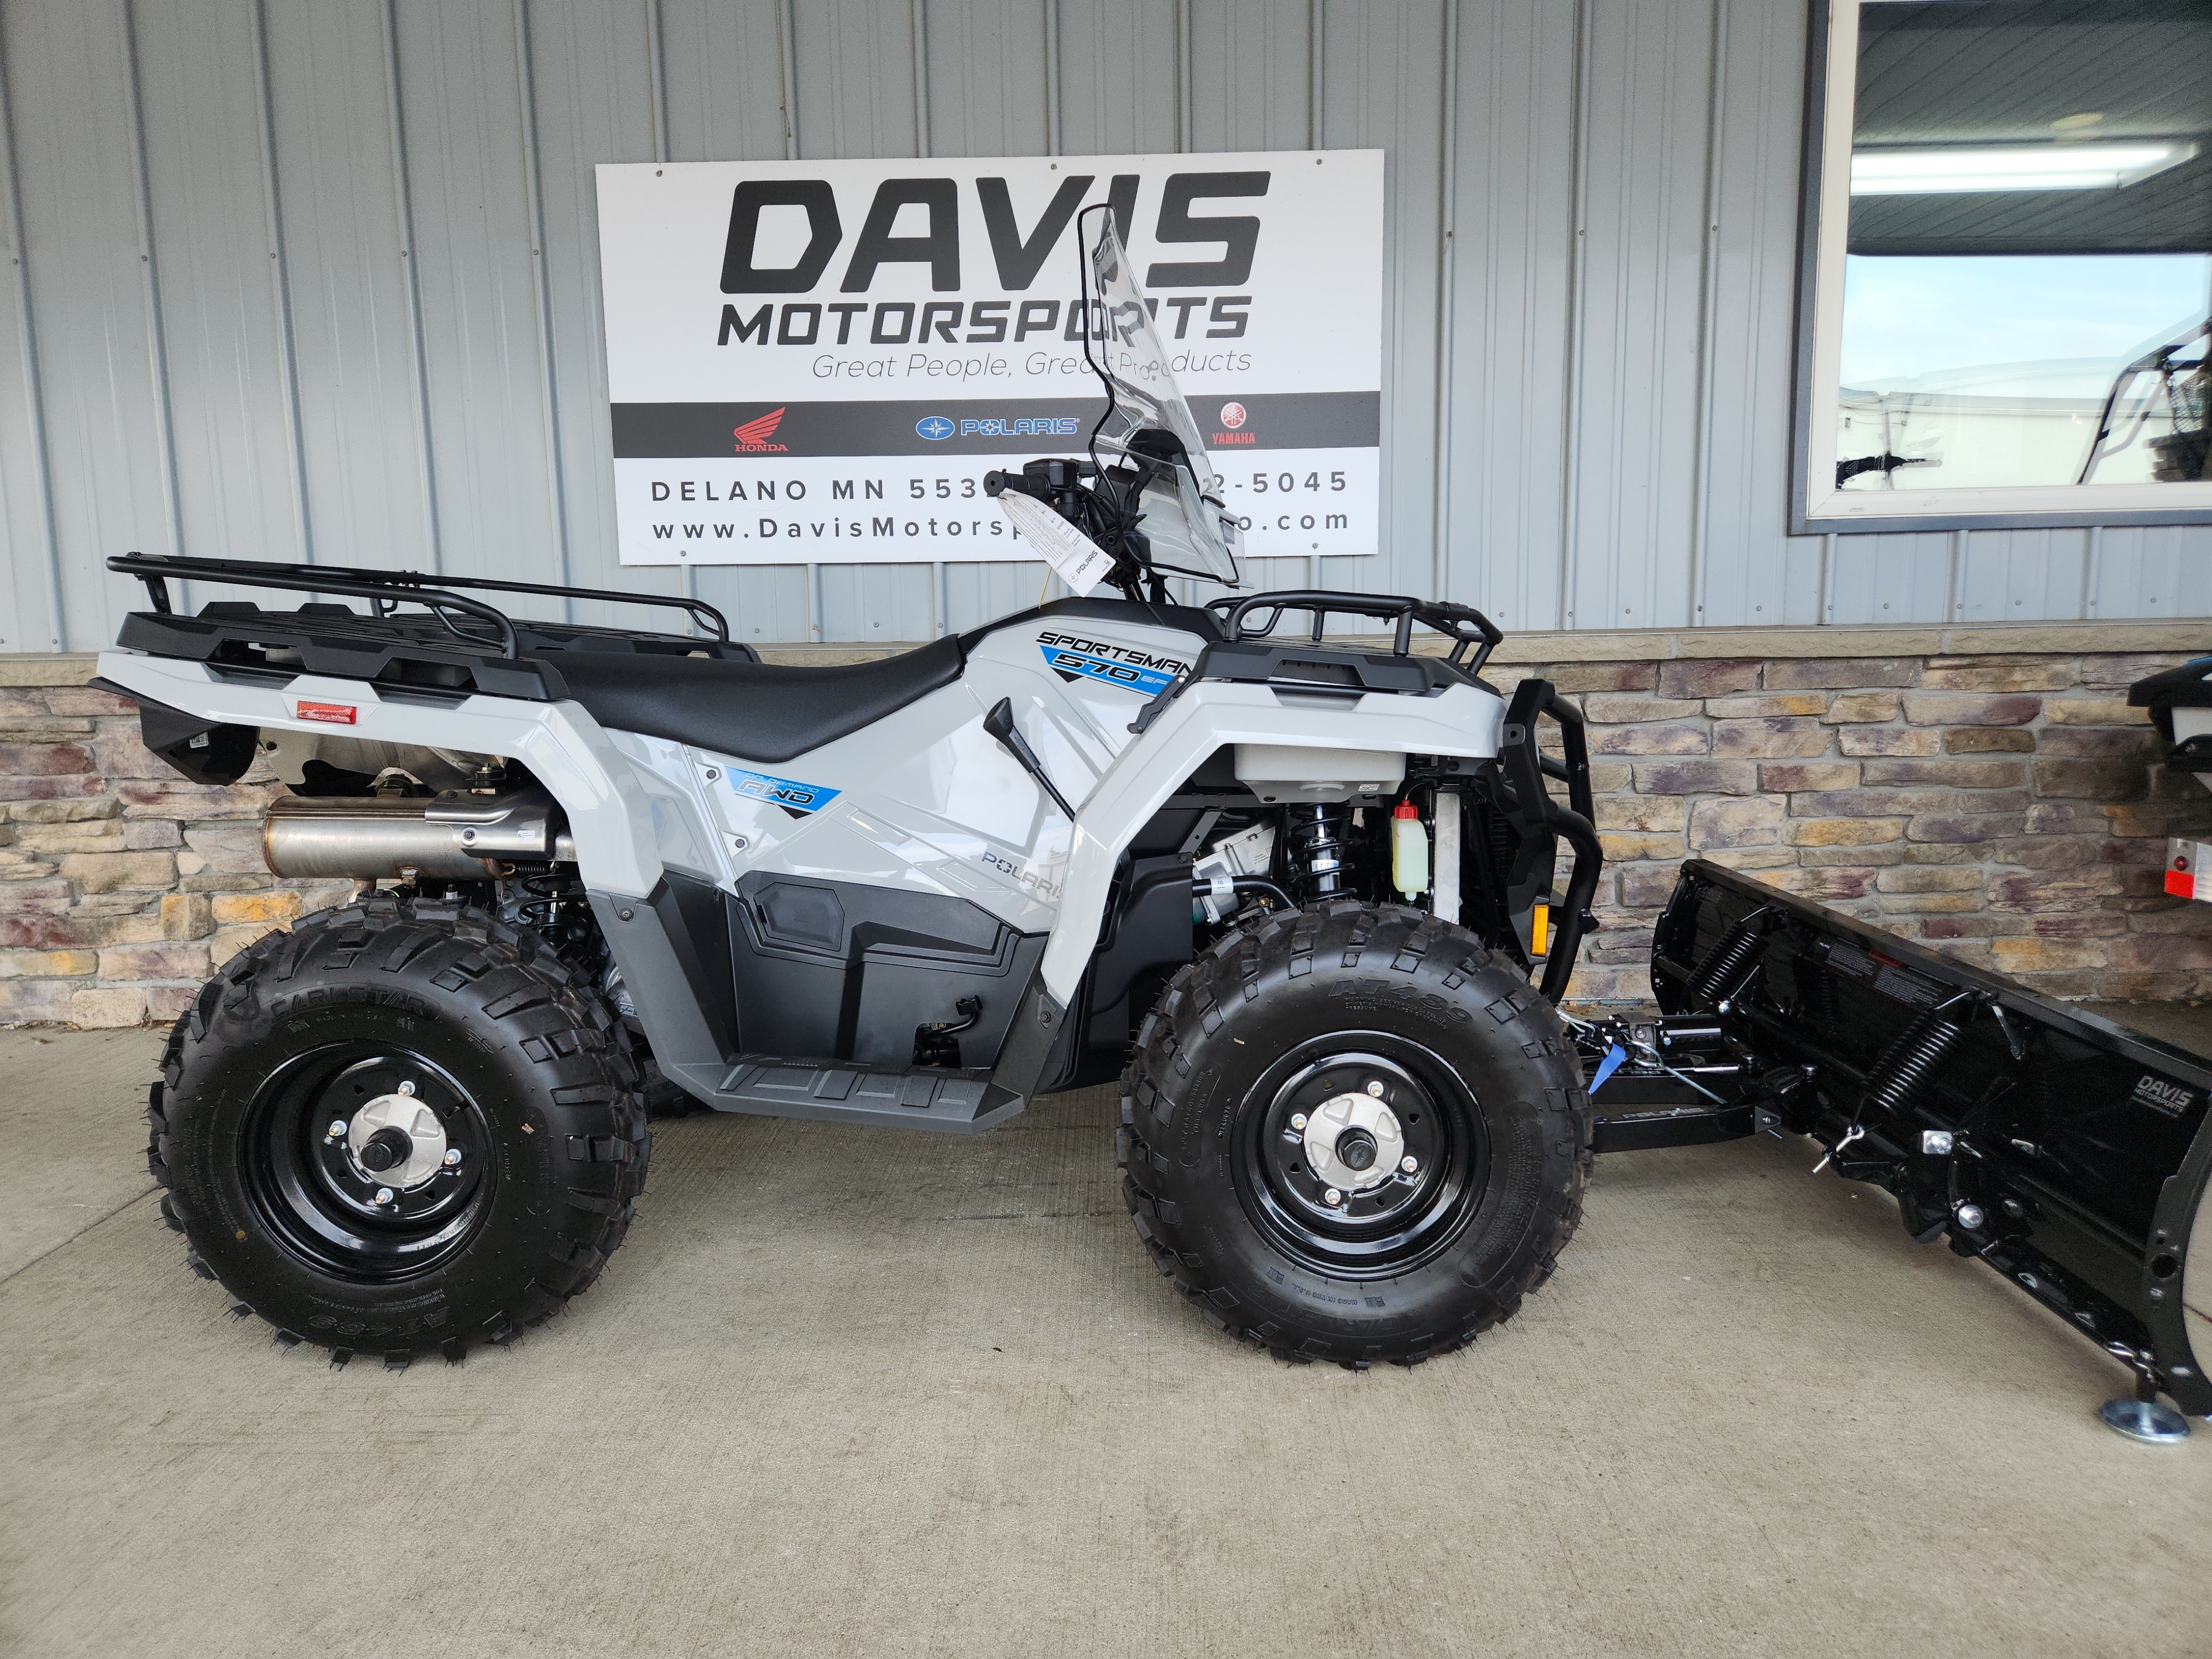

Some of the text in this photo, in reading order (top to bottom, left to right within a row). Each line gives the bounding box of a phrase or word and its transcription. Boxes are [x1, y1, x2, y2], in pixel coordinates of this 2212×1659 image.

[720, 171, 1271, 294] DAVIS
[717, 296, 1252, 347] MOTORSPORTS
[813, 354, 897, 378] Great
[907, 353, 1012, 383] People,
[961, 417, 1077, 436] POLARIS
[1212, 432, 1255, 445] YAMAHA
[734, 443, 789, 452] HONDA
[651, 471, 1347, 501] DELANO MN 553 2-5045
[1238, 514, 1348, 531] o.com
[1076, 550, 1098, 575] POLARIS
[1035, 631, 1192, 675] SPORTSMAN
[1052, 652, 1168, 685] 570 EP
[737, 780, 815, 805] AWD
[768, 777, 820, 794] DEMAND
[980, 851, 1062, 899] POLARI
[1328, 978, 1474, 1024] AT489
[2133, 1087, 2185, 1113] MOTORSPORTS
[2137, 1075, 2194, 1107] DAVIS
[1312, 1292, 1326, 1302] THE
[1337, 1298, 1358, 1306] MADE
